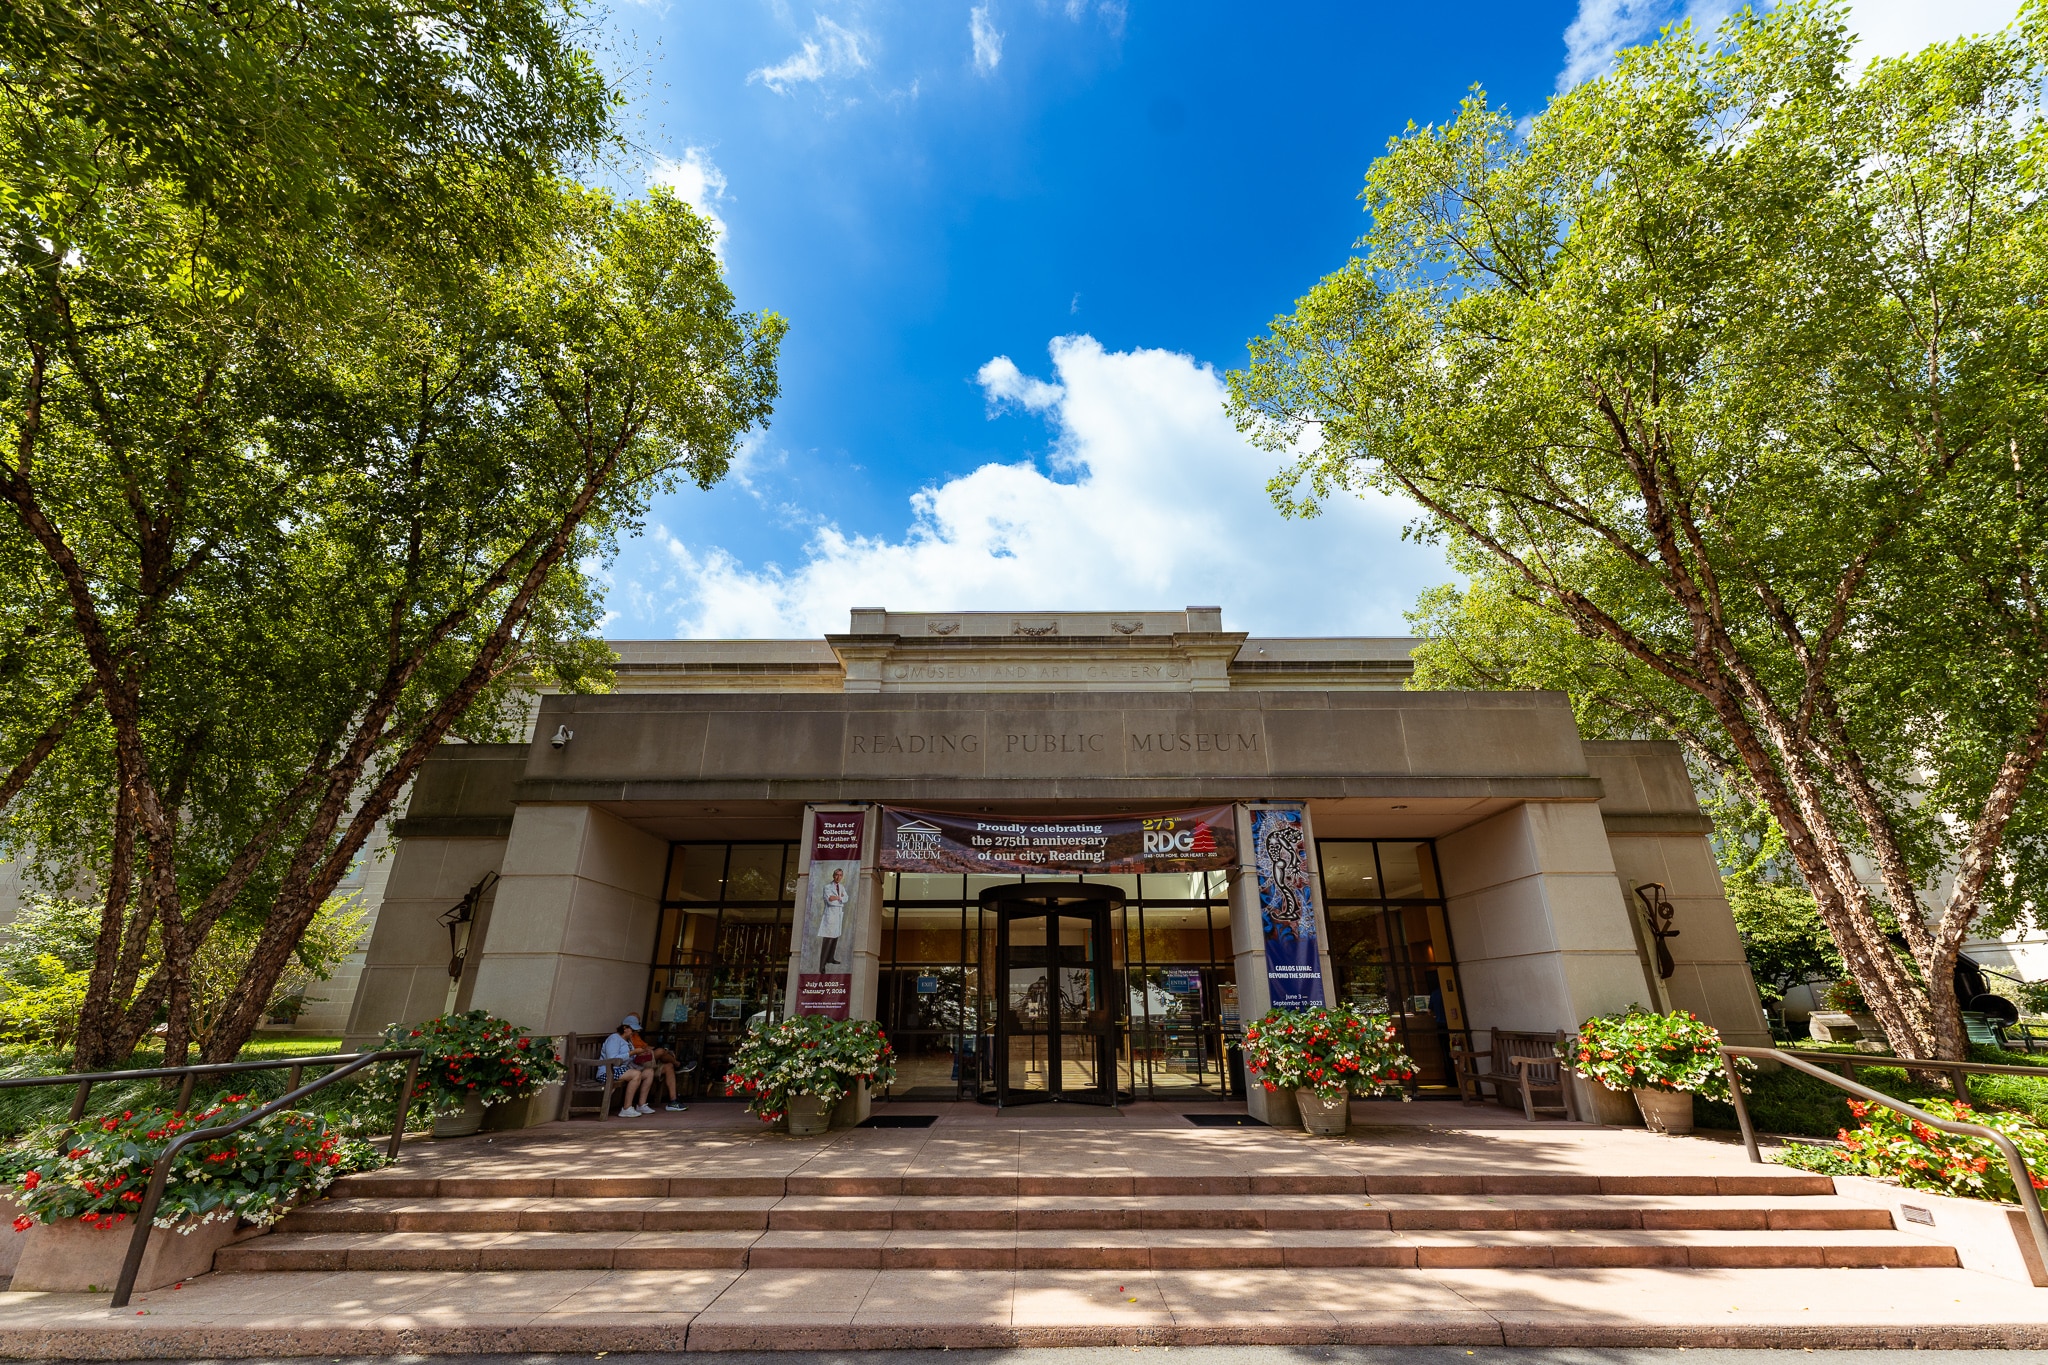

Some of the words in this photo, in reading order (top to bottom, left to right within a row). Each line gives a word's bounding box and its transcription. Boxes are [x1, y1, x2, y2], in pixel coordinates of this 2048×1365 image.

[910, 666, 981, 679] MUSEUM
[994, 666, 1027, 679] AND
[1040, 666, 1073, 679] ART
[1087, 666, 1161, 678] GALLERY
[851, 734, 978, 754] READING
[1005, 734, 1104, 753] PUBLIC
[1131, 733, 1259, 752] MUSEUM
[976, 822, 1027, 834] Proudly
[1030, 824, 1103, 834] celebrating
[896, 833, 941, 843] READING
[971, 835, 992, 846] the
[995, 835, 1030, 847] 275th
[1032, 835, 1108, 848] anniversary
[1143, 829, 1195, 853] RDG
[901, 841, 937, 851] PUBLIC
[895, 850, 941, 860] MUSEUM
[977, 851, 991, 861] of
[994, 853, 1016, 861] our
[1019, 850, 1046, 863] city,
[1049, 850, 1105, 863] Reading!
